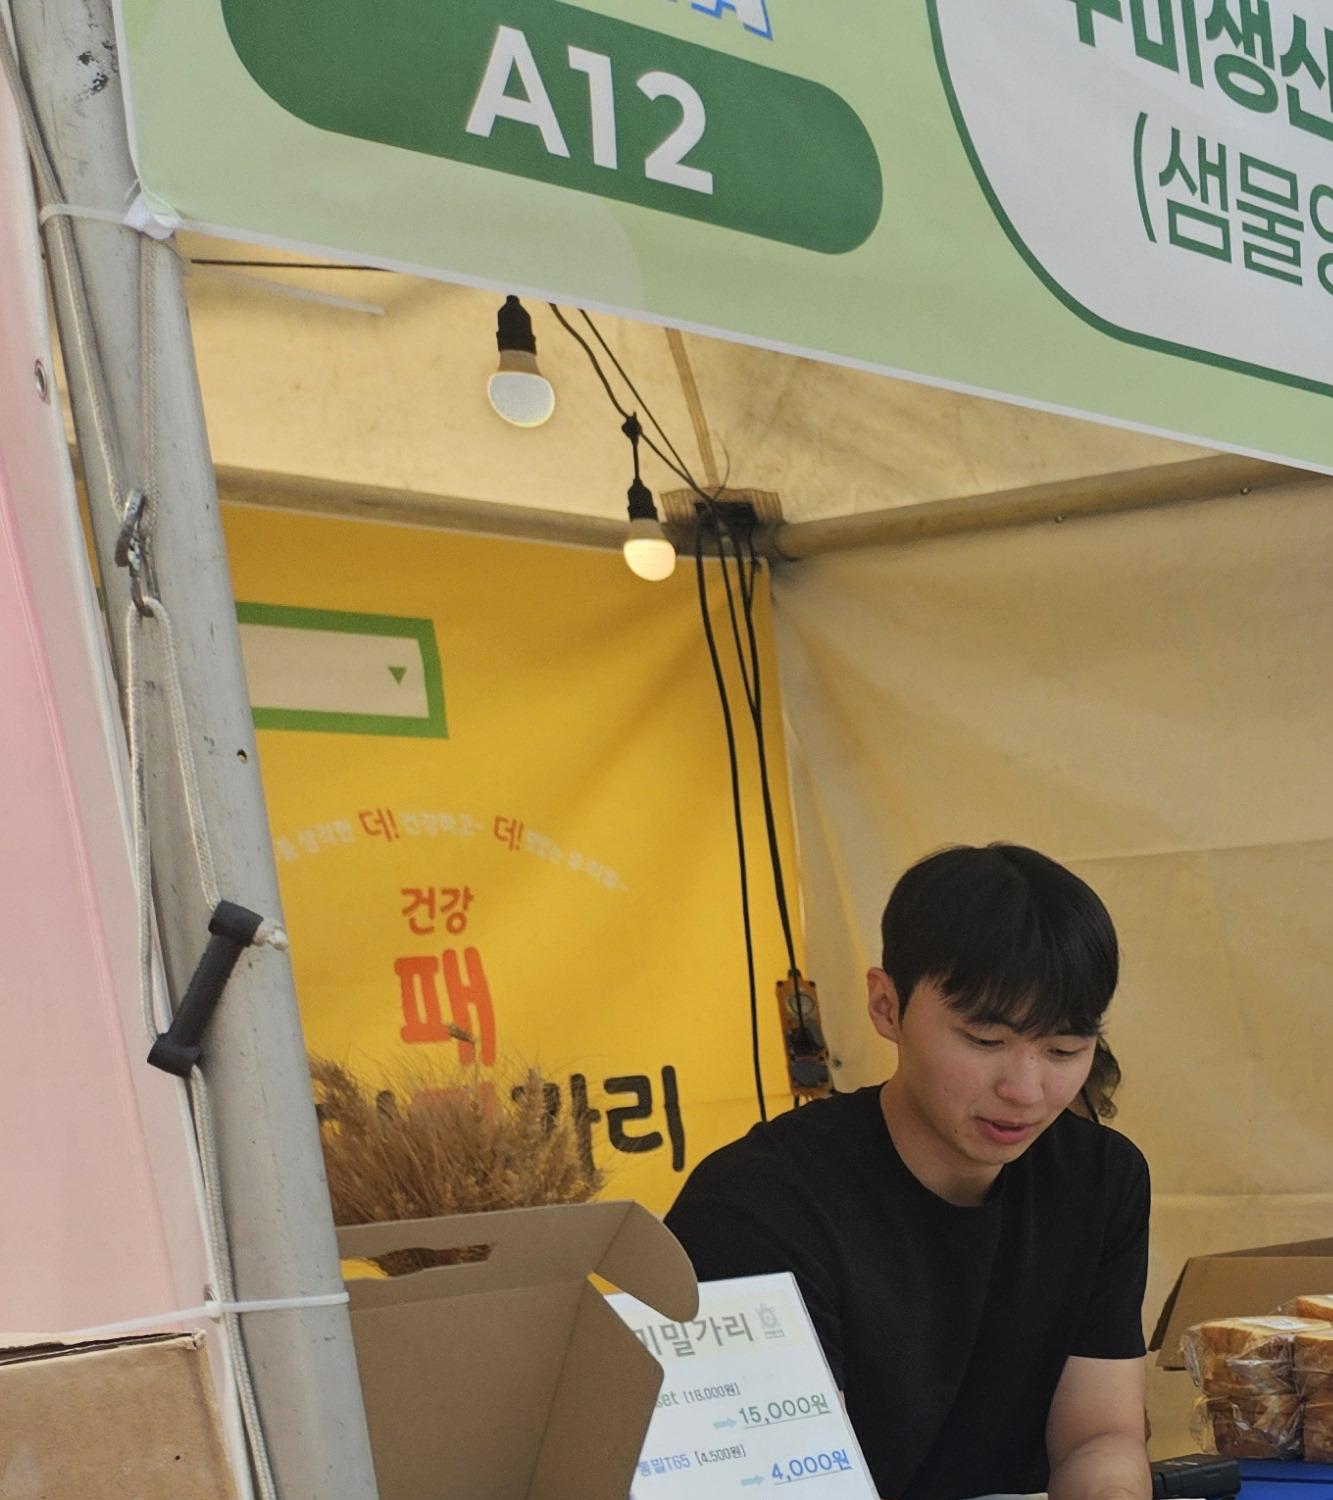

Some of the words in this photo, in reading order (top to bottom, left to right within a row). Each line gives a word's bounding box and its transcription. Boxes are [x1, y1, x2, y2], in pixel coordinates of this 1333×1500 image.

[465, 25, 714, 195] A12
[400, 886, 473, 936] 건강
[393, 946, 497, 1068] 패
[738, 1391, 833, 1428] 15,000원
[770, 1447, 854, 1484] 4,000원
